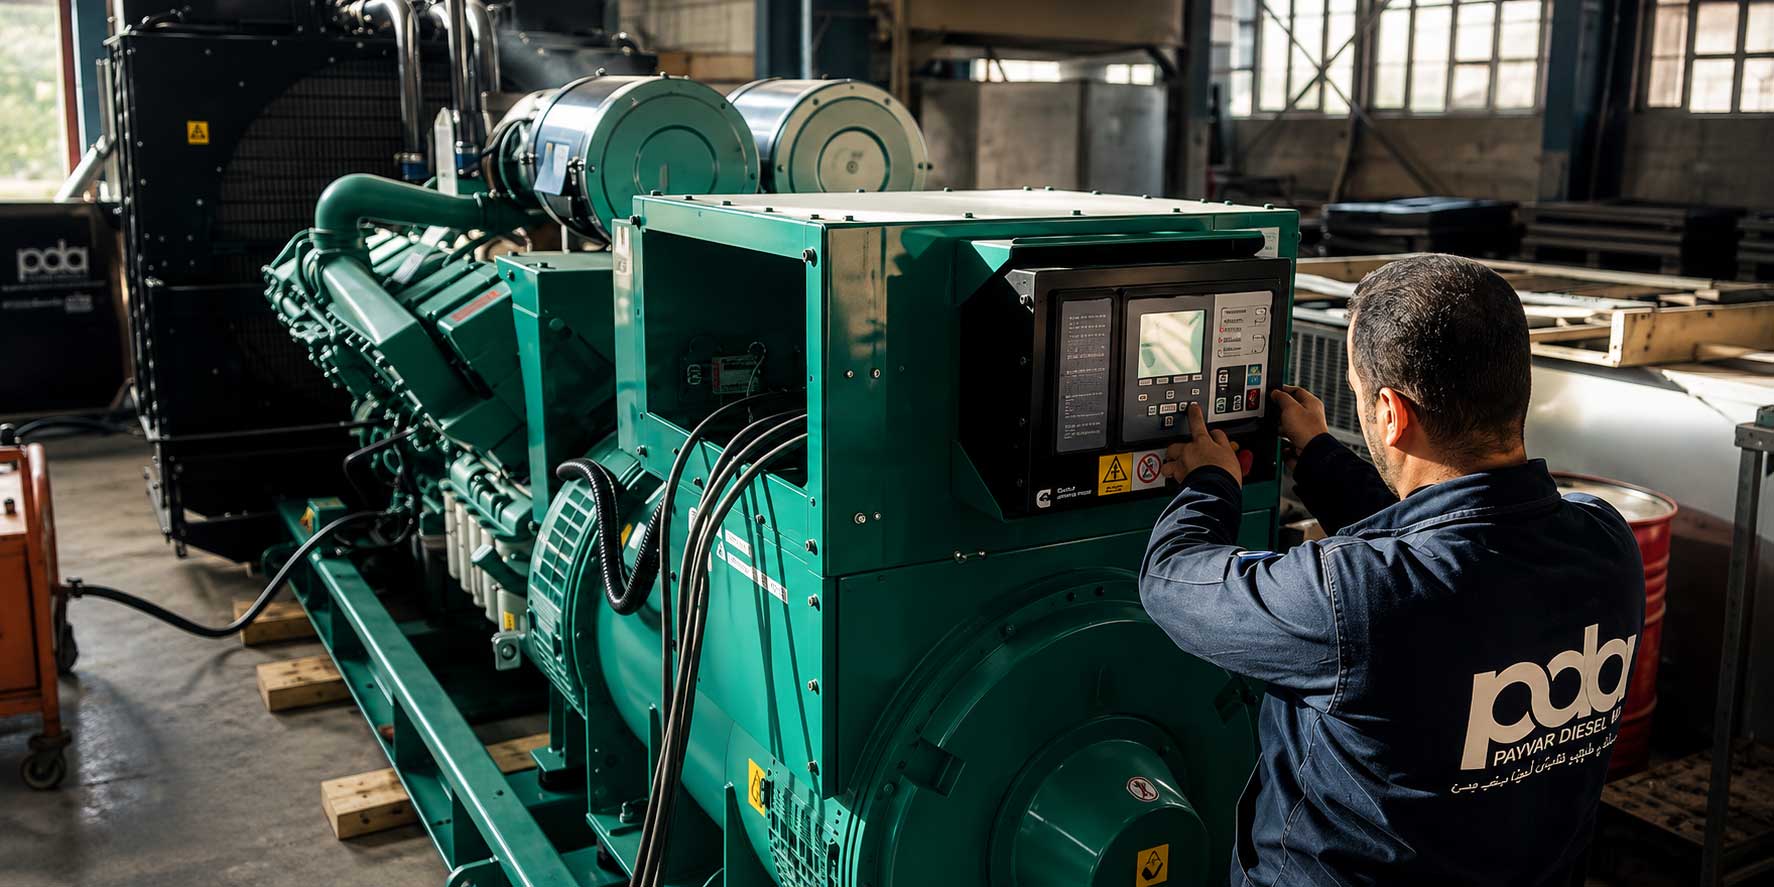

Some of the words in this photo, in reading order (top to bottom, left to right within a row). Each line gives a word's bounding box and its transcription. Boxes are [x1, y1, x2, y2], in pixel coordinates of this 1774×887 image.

[17, 239, 88, 282] pda
[1460, 623, 1637, 771] pda
[1493, 733, 1556, 767] PAYVAR
[1559, 717, 1607, 744] DIESEL
